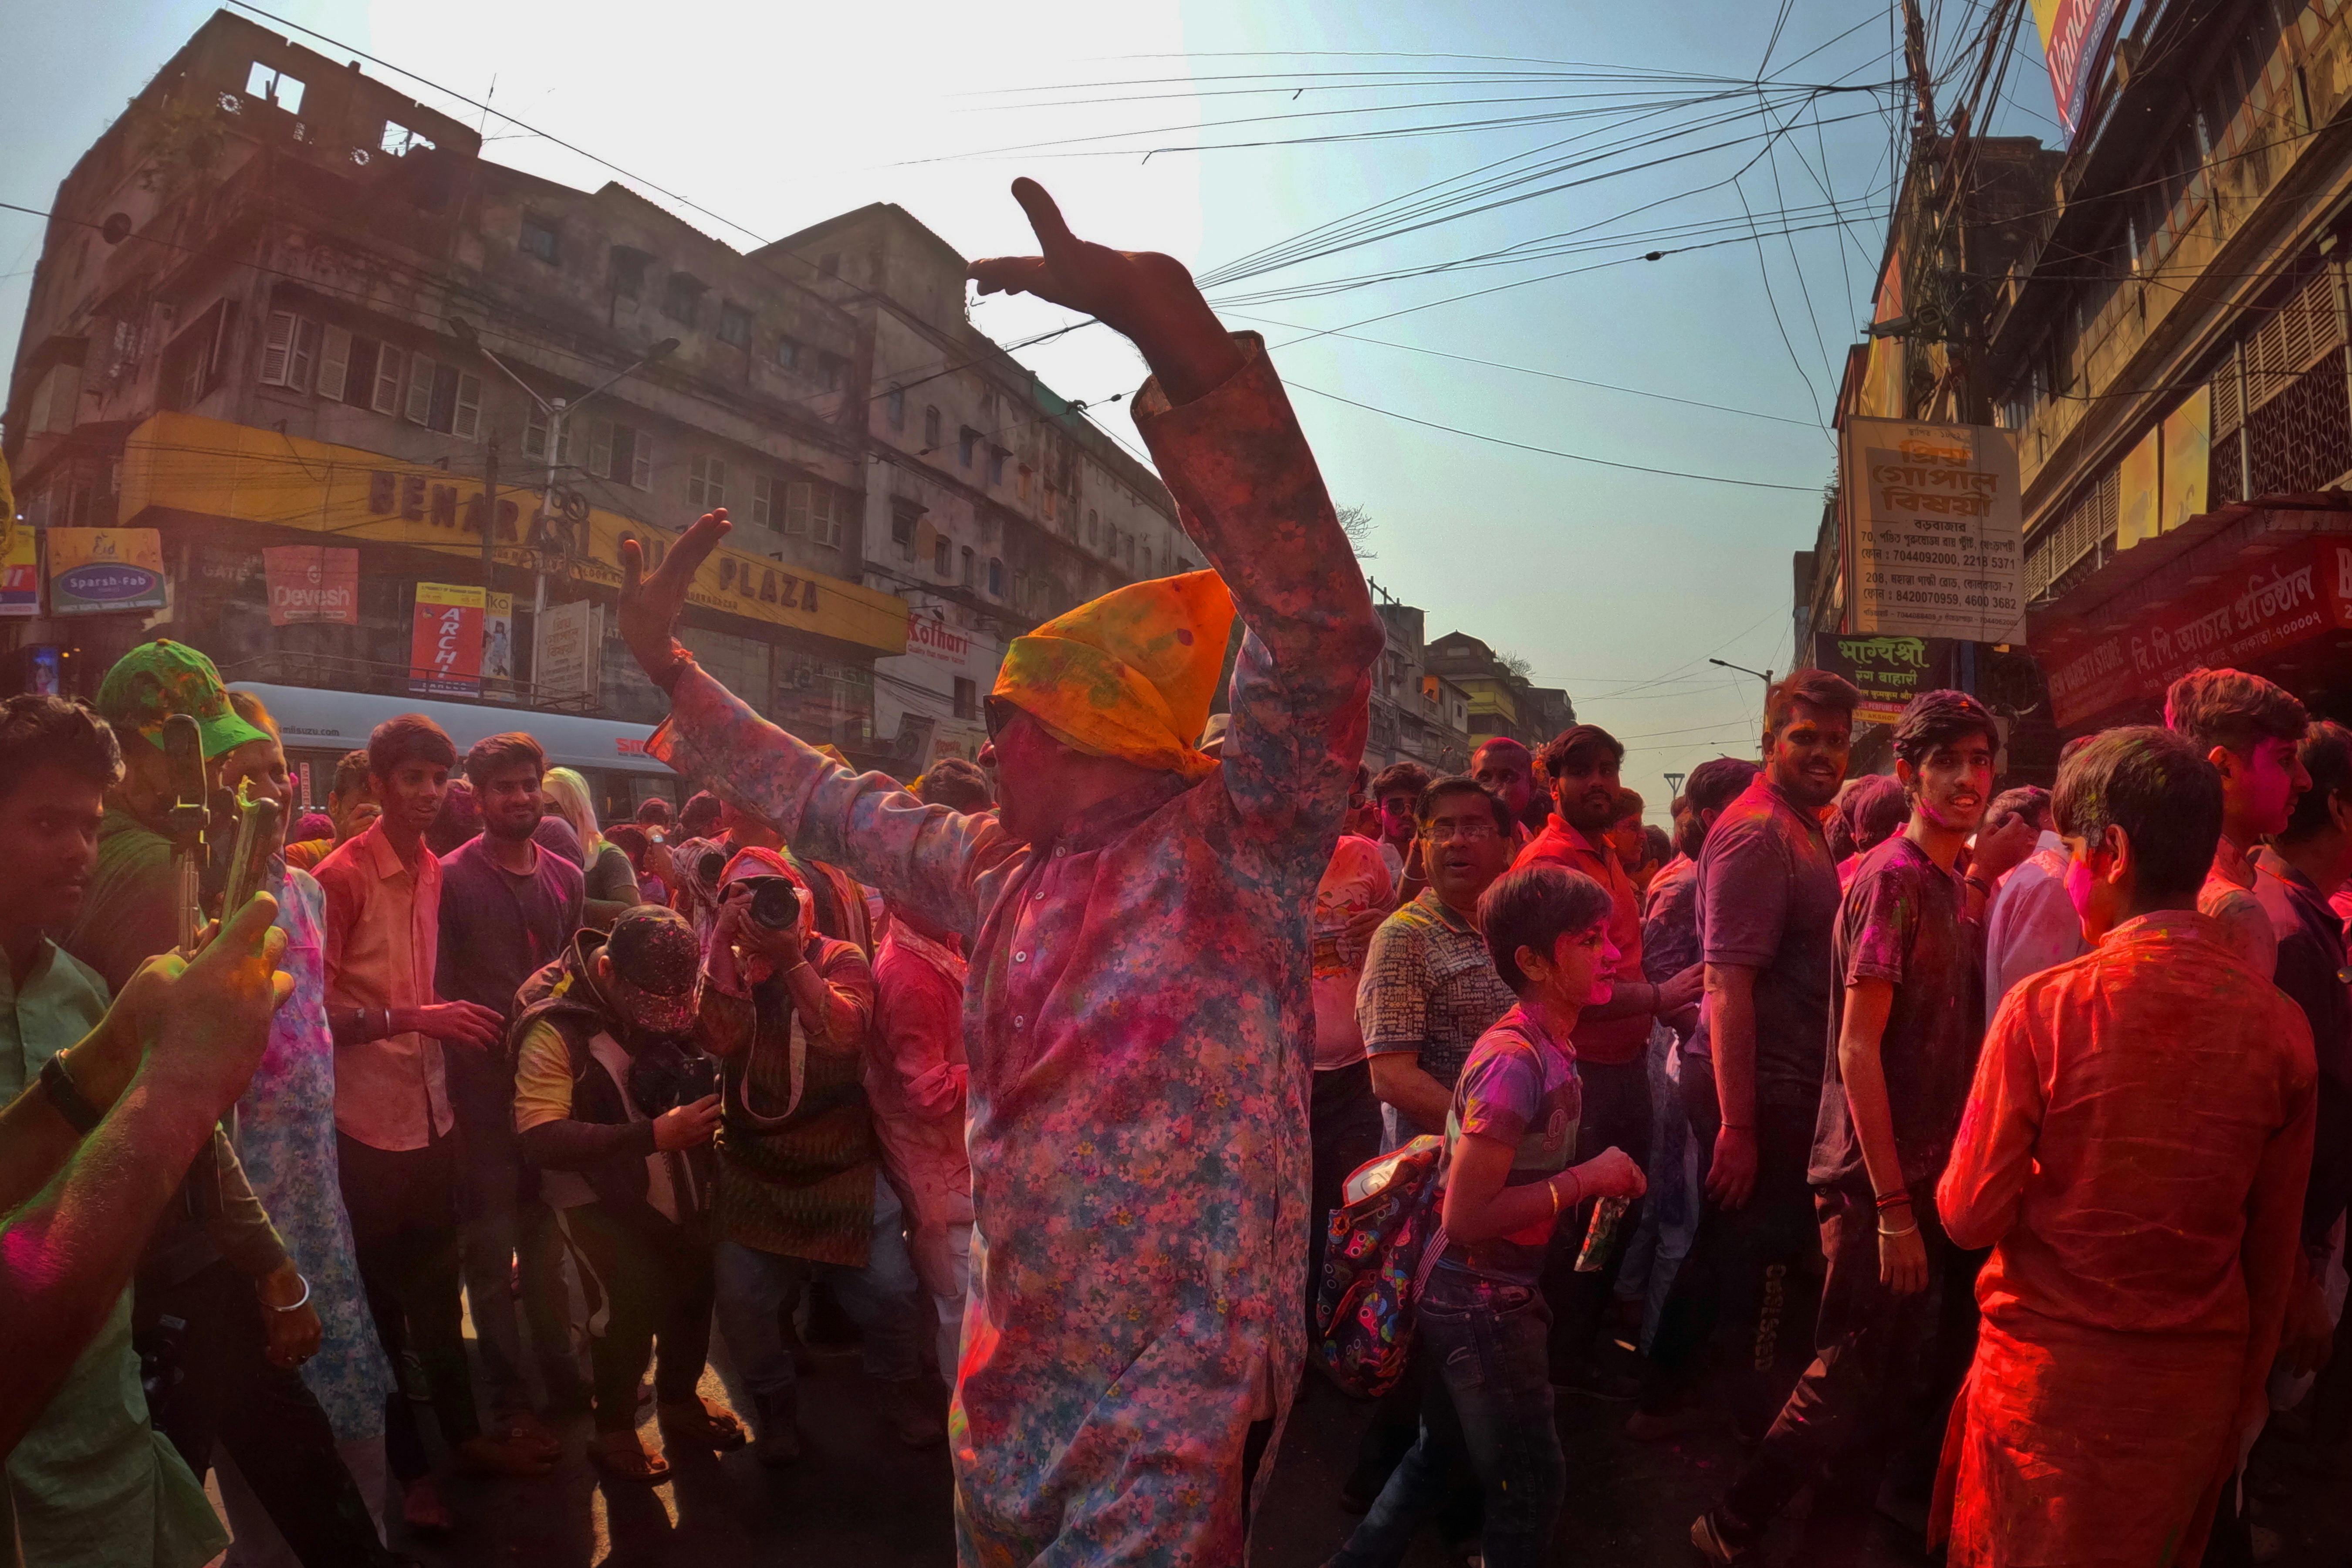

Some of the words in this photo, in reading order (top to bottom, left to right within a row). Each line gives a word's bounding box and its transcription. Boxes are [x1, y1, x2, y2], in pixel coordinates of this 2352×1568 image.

[1899, 439, 1968, 468] প্রিয়
[1873, 465, 1999, 493] গোপাল
[1881, 486, 1994, 517] বিষয়ী
[1861, 531, 1877, 544] 70,
[1913, 519, 1967, 533] বড়বাজার
[1862, 548, 1882, 560] ফোন
[1893, 550, 1960, 567] 7044092000,
[1963, 554, 1988, 567] 2218
[1992, 556, 2015, 570] 5371
[720, 557, 818, 612] PLAZA
[1866, 572, 1888, 585] 208,
[274, 585, 350, 606] Devesh
[1864, 588, 1885, 600] ফোন
[1896, 590, 1962, 607] 8420070959,
[1965, 595, 1989, 607] 4600
[1992, 596, 2017, 610] 3682
[2235, 564, 2315, 630] প্রতিষ্ঠান
[434, 607, 460, 679] ARCHI
[907, 613, 968, 656] Kothari
[1838, 637, 1930, 668] भाग्यश्री
[1869, 702, 1893, 712] PERFUME
[301, 764, 311, 814] EMERGEN
[1543, 1108, 1567, 1152] 9
